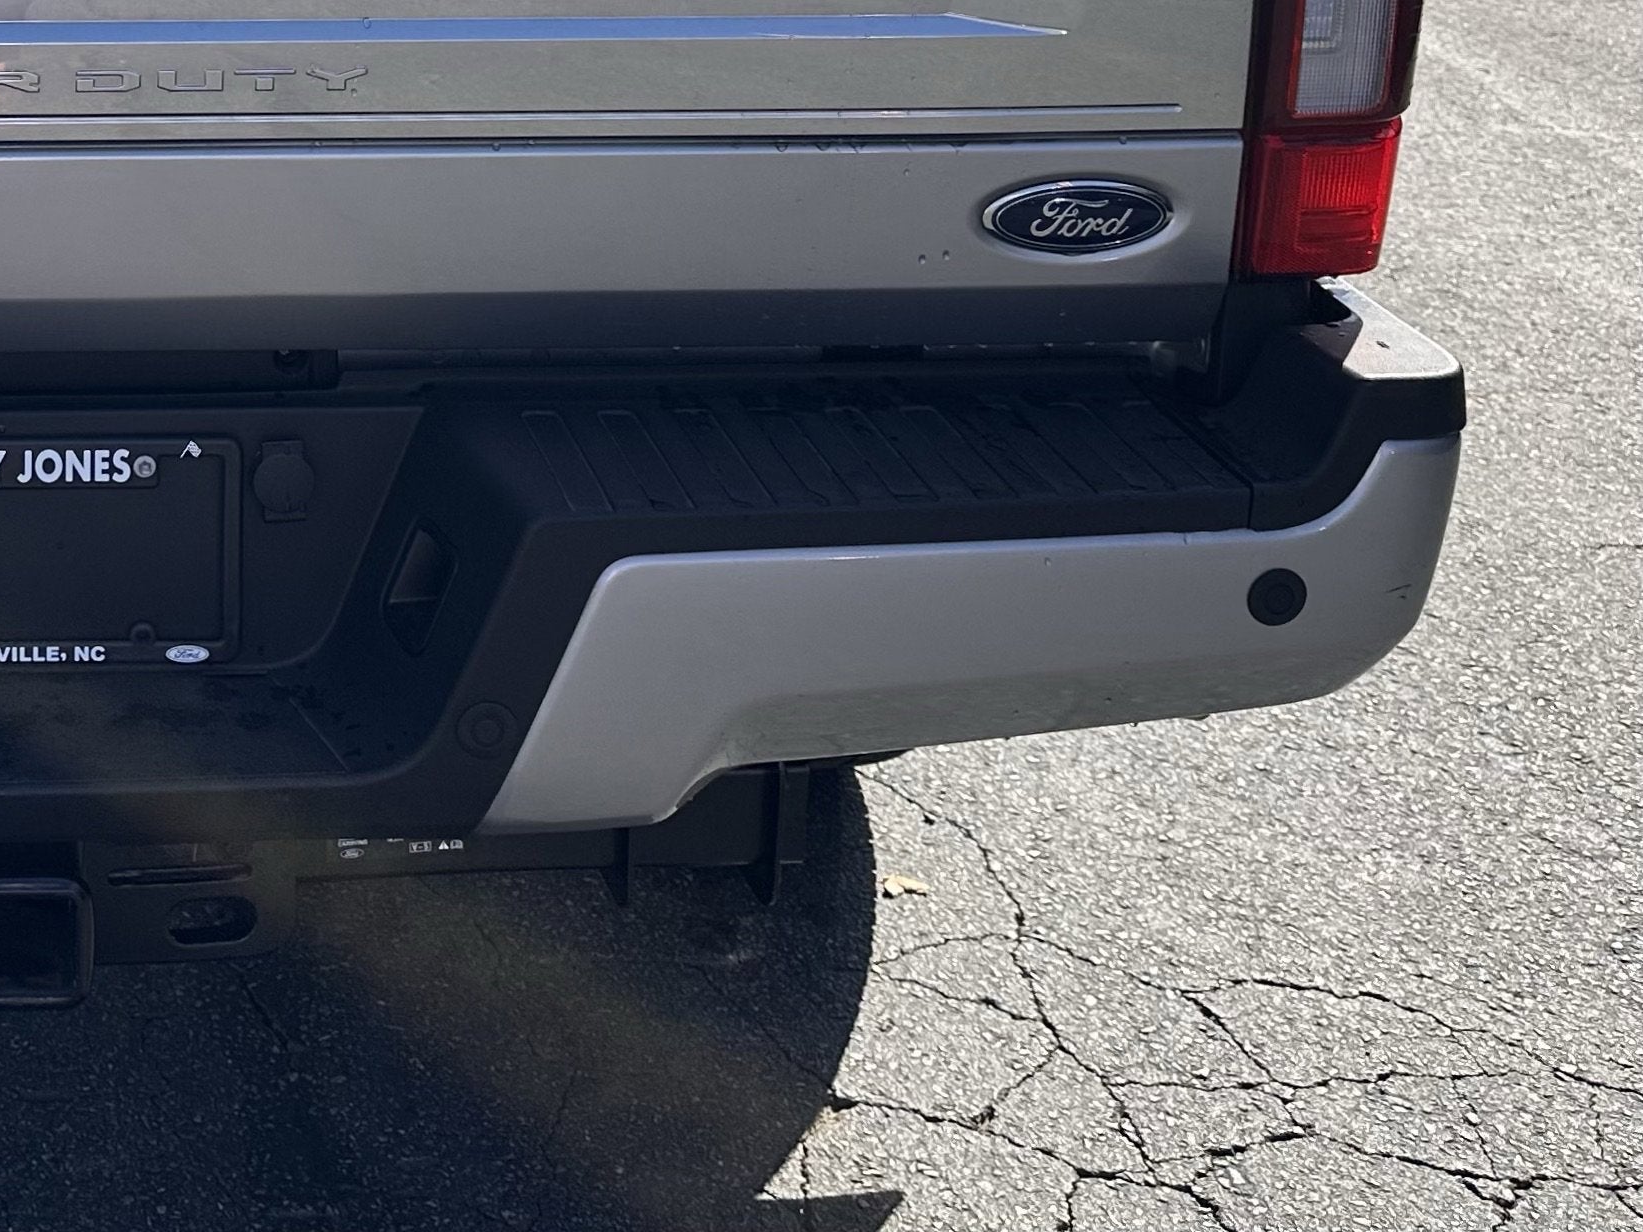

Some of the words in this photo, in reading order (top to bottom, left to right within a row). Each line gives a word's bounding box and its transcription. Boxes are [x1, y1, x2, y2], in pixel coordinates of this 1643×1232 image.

[74, 67, 369, 94] DUTY
[1029, 197, 1134, 238] Ford
[17, 449, 132, 483] JONES
[73, 645, 107, 662] NC
